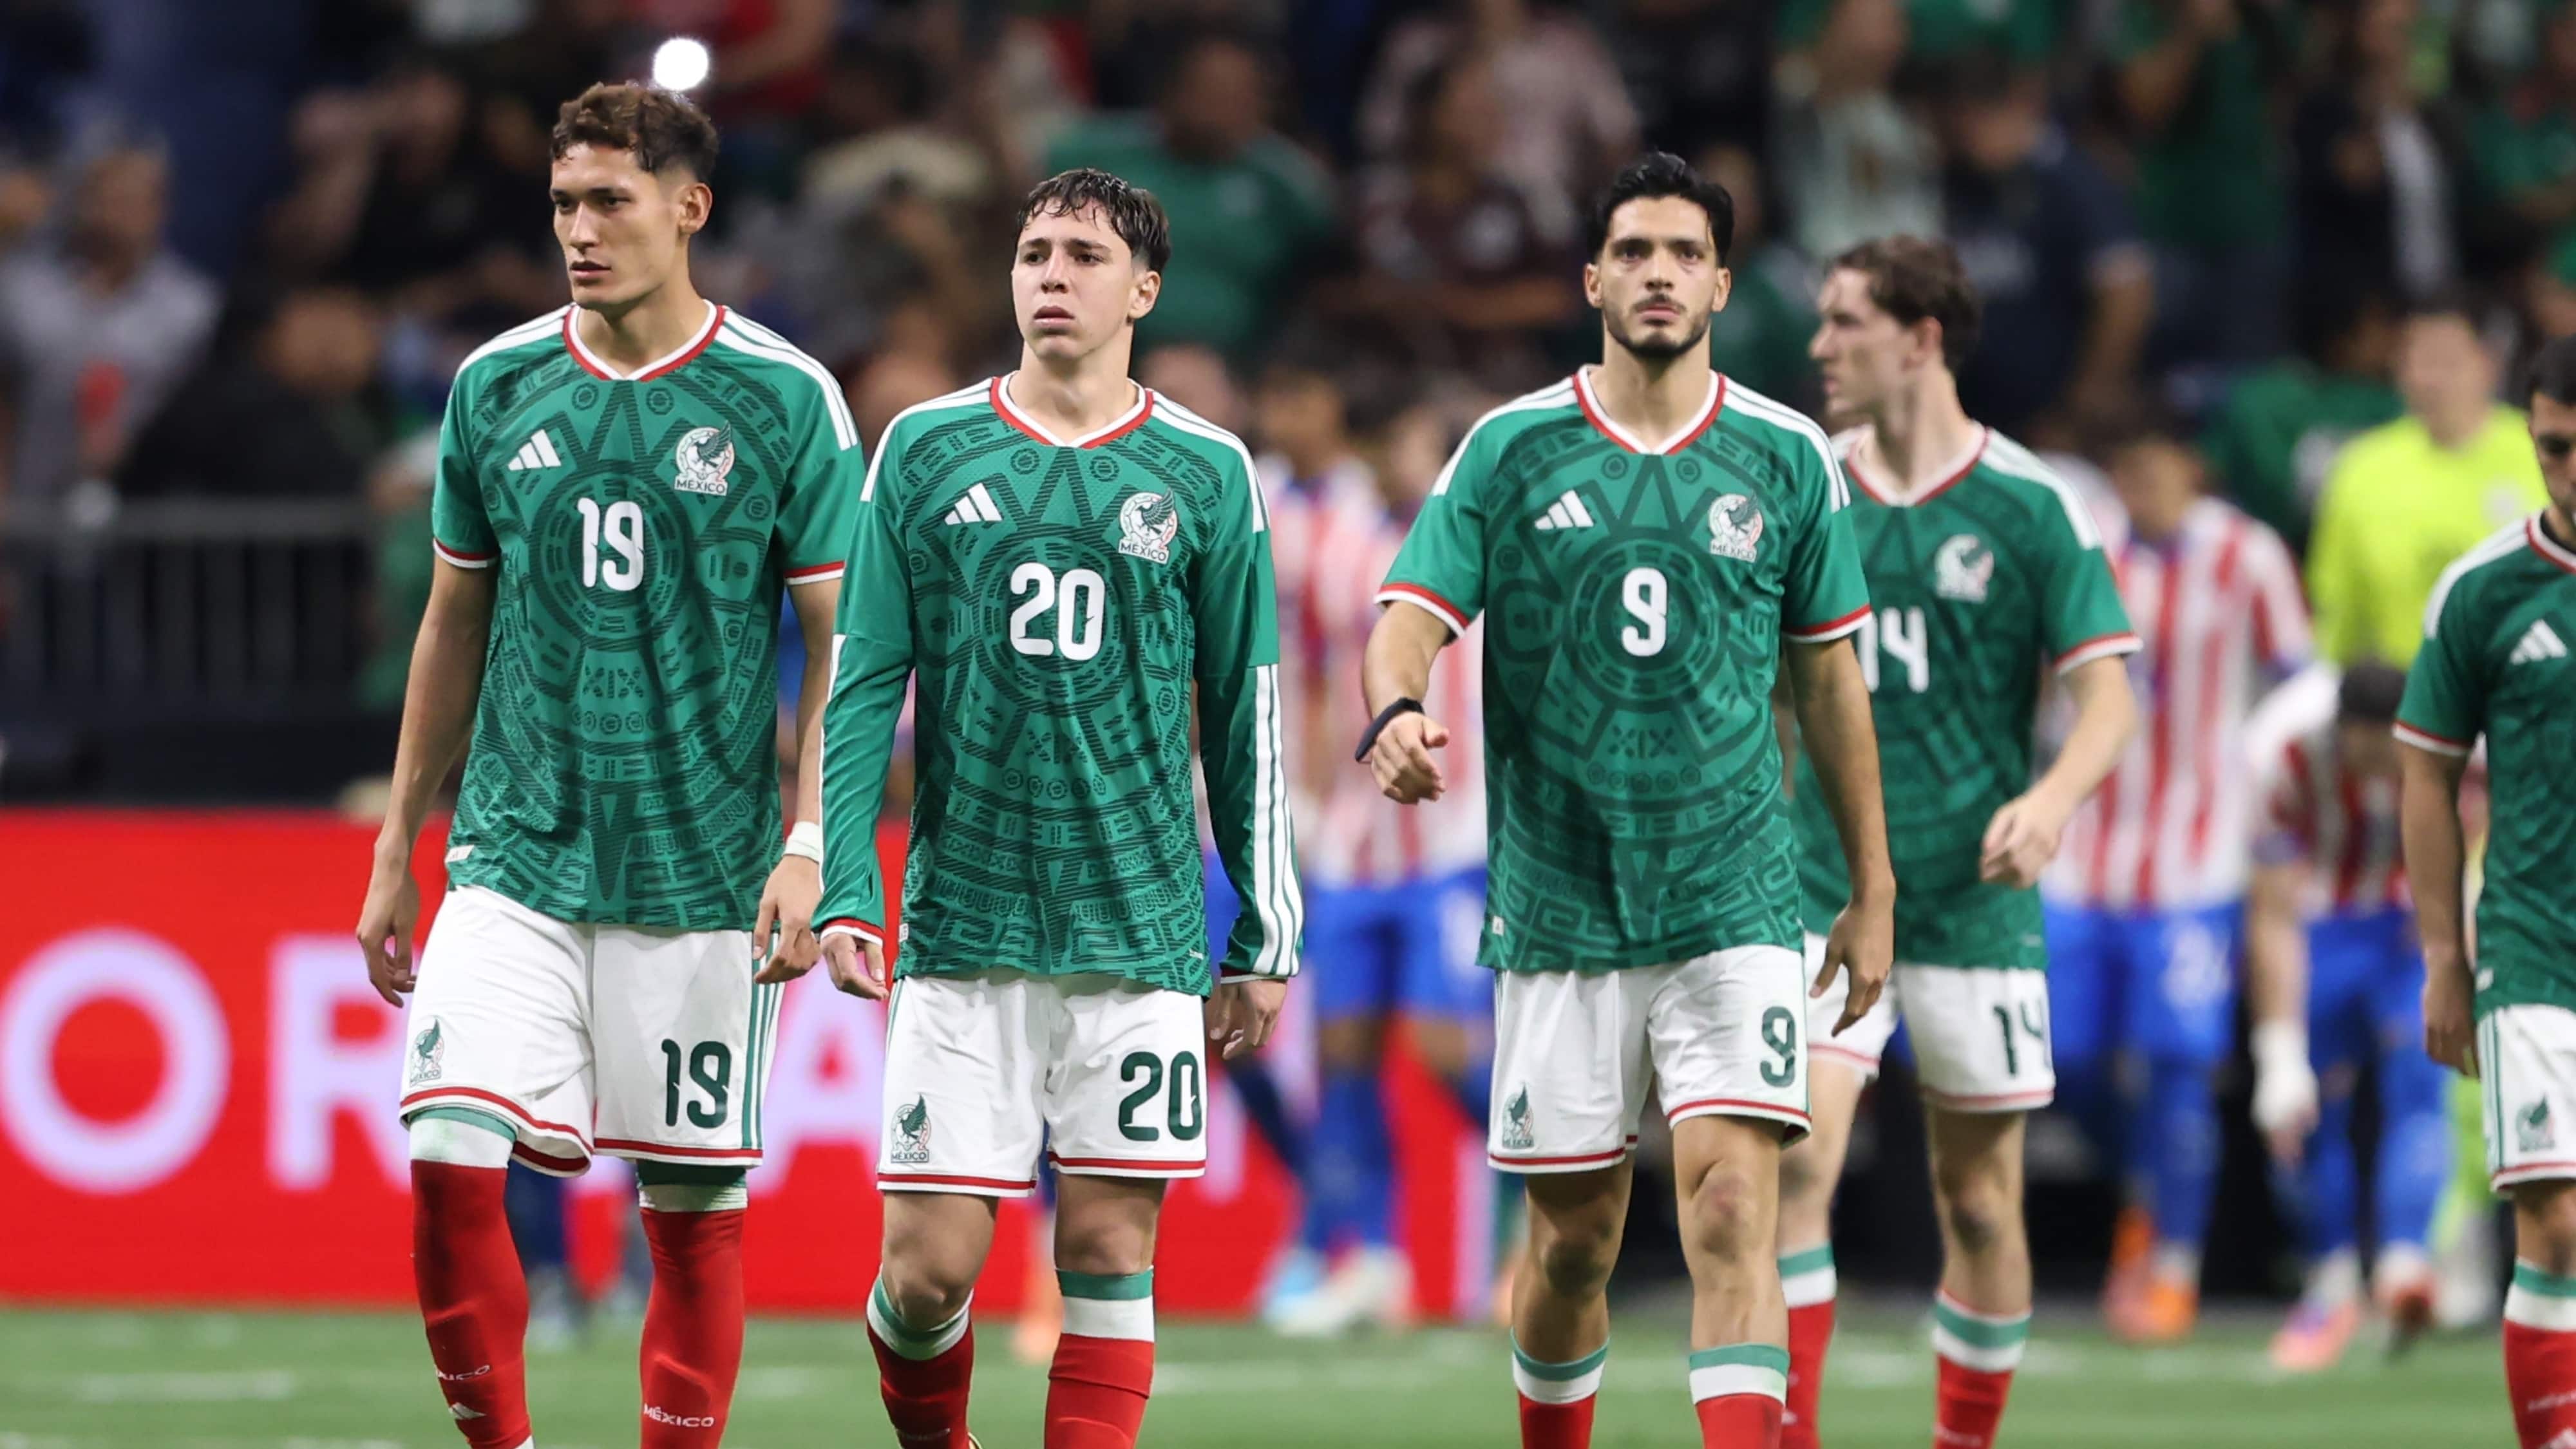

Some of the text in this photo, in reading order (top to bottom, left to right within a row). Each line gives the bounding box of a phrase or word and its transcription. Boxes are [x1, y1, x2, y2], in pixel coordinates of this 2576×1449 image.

[578, 498, 643, 591] 19
[1010, 562, 1105, 660] 20
[1622, 567, 1667, 656] 9
[1857, 606, 1930, 694] 14
[661, 1038, 732, 1129] 19
[1760, 1006, 1795, 1088] 9
[1118, 1050, 1202, 1141] 20
